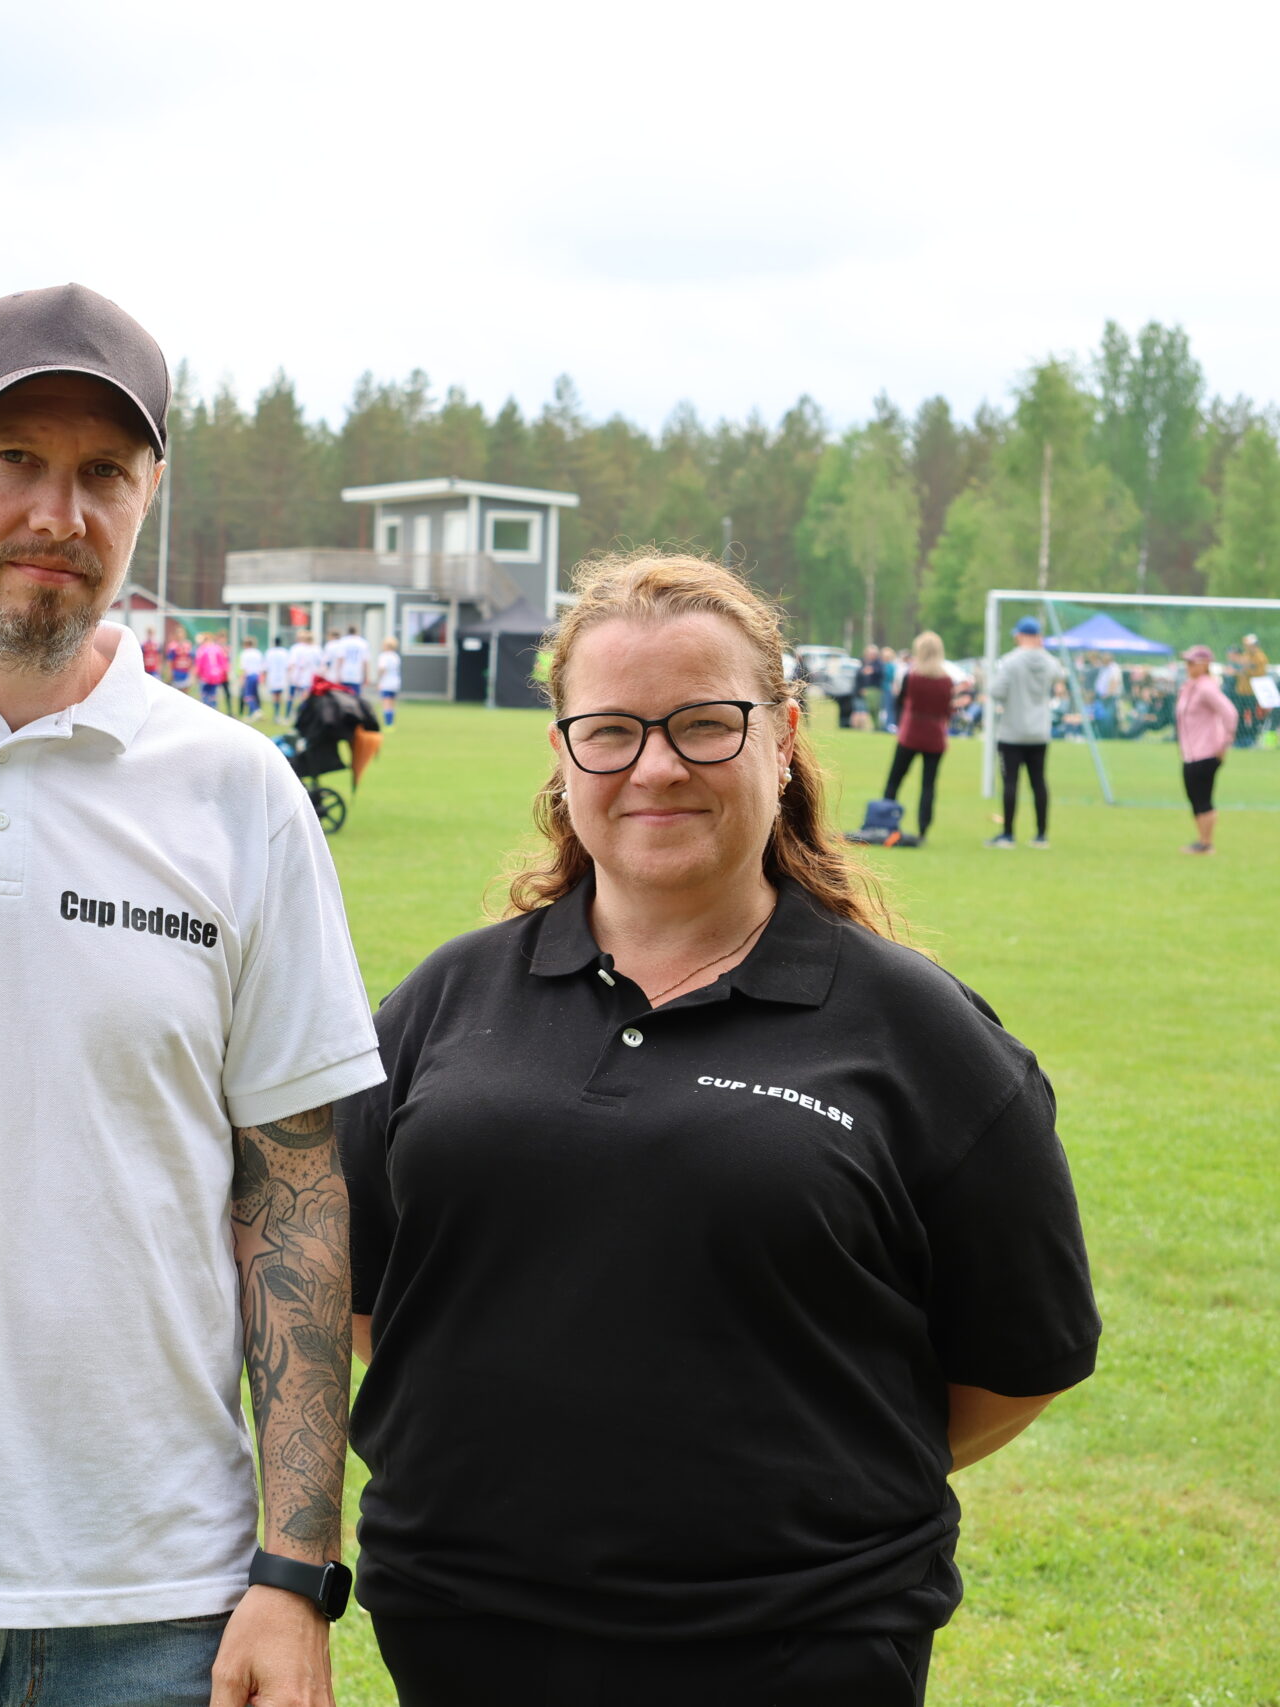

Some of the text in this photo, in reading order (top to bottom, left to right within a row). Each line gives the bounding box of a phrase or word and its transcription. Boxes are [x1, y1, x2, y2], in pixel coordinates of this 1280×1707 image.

[60, 890, 218, 948] Cup ledelse
[697, 1076, 854, 1131] CUP LEDELSE
[303, 1400, 341, 1445] FAMILY
[283, 1441, 329, 1483] BEGINS
